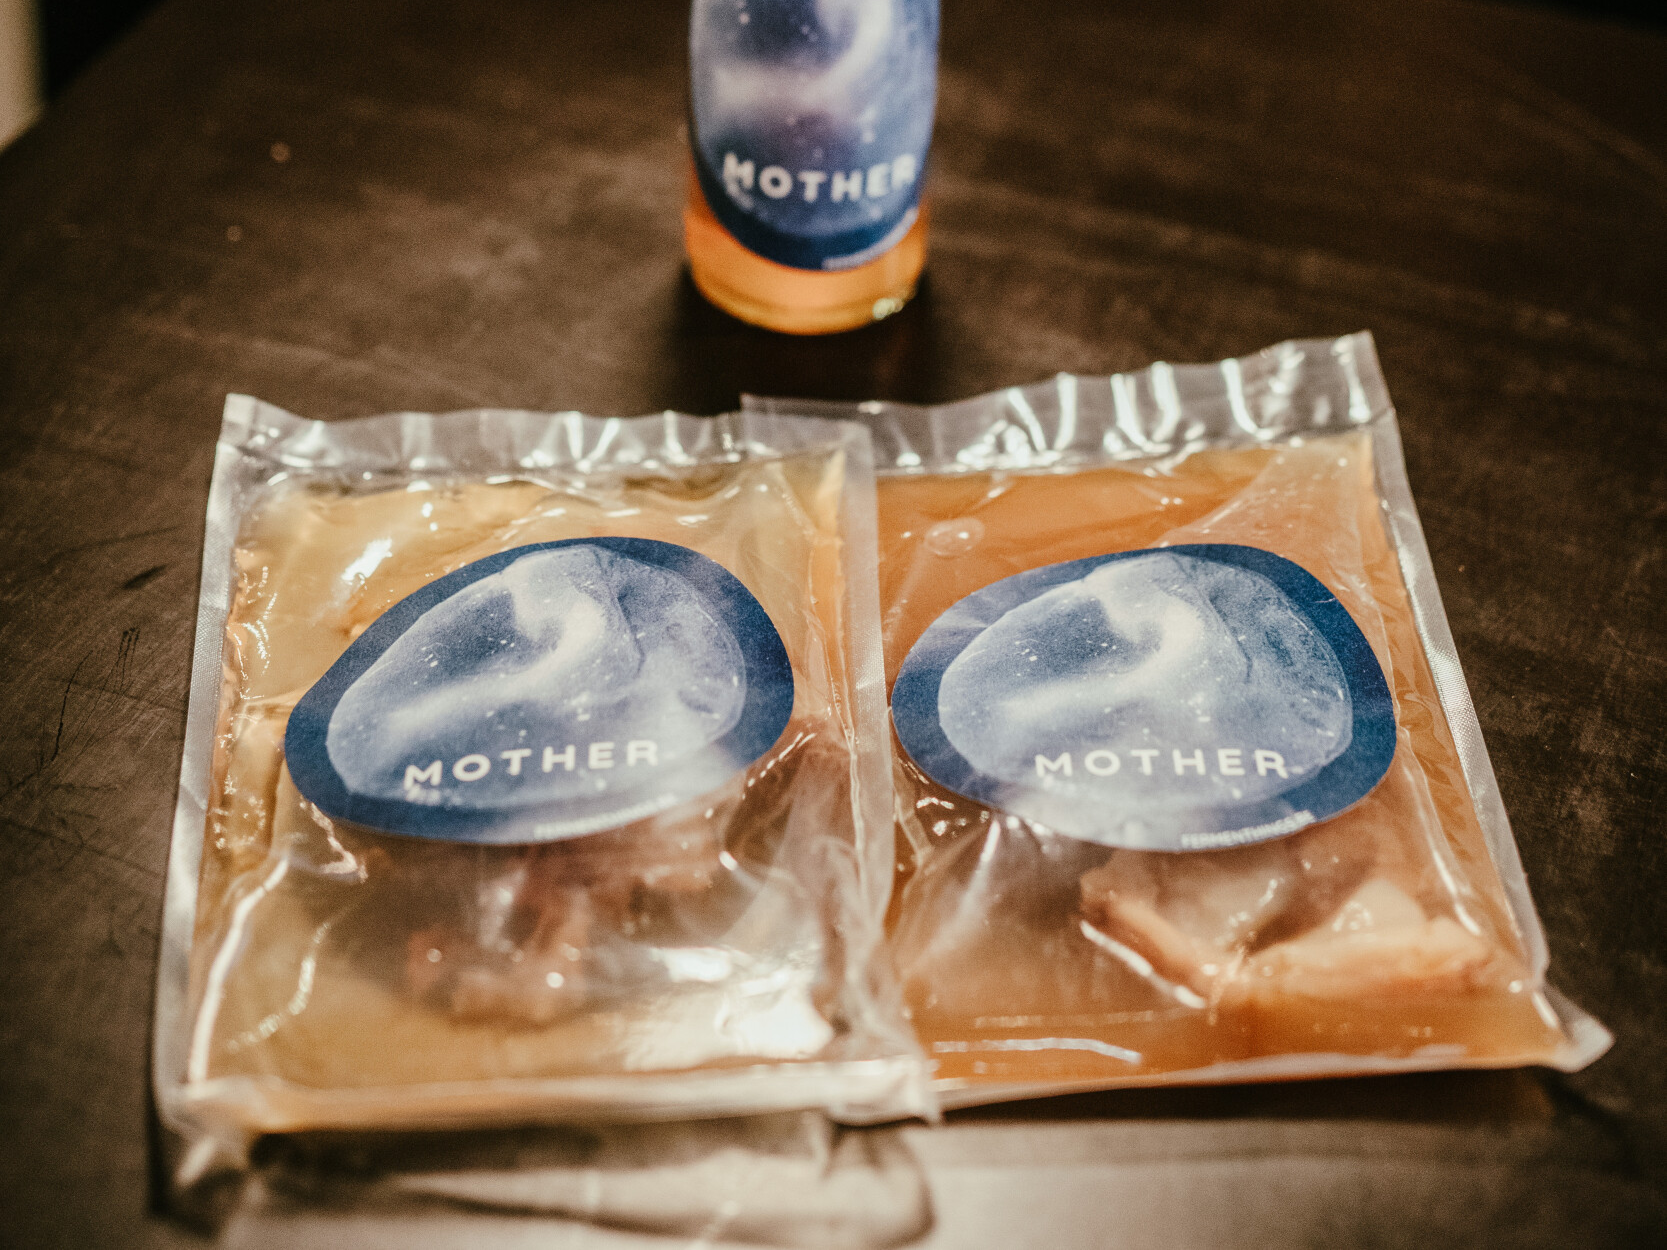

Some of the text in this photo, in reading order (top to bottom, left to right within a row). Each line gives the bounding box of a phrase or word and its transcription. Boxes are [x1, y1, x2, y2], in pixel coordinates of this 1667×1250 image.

[722, 152, 917, 203] MOTHER
[403, 739, 659, 791] MOTHER
[1034, 748, 1289, 780] MOTHER
